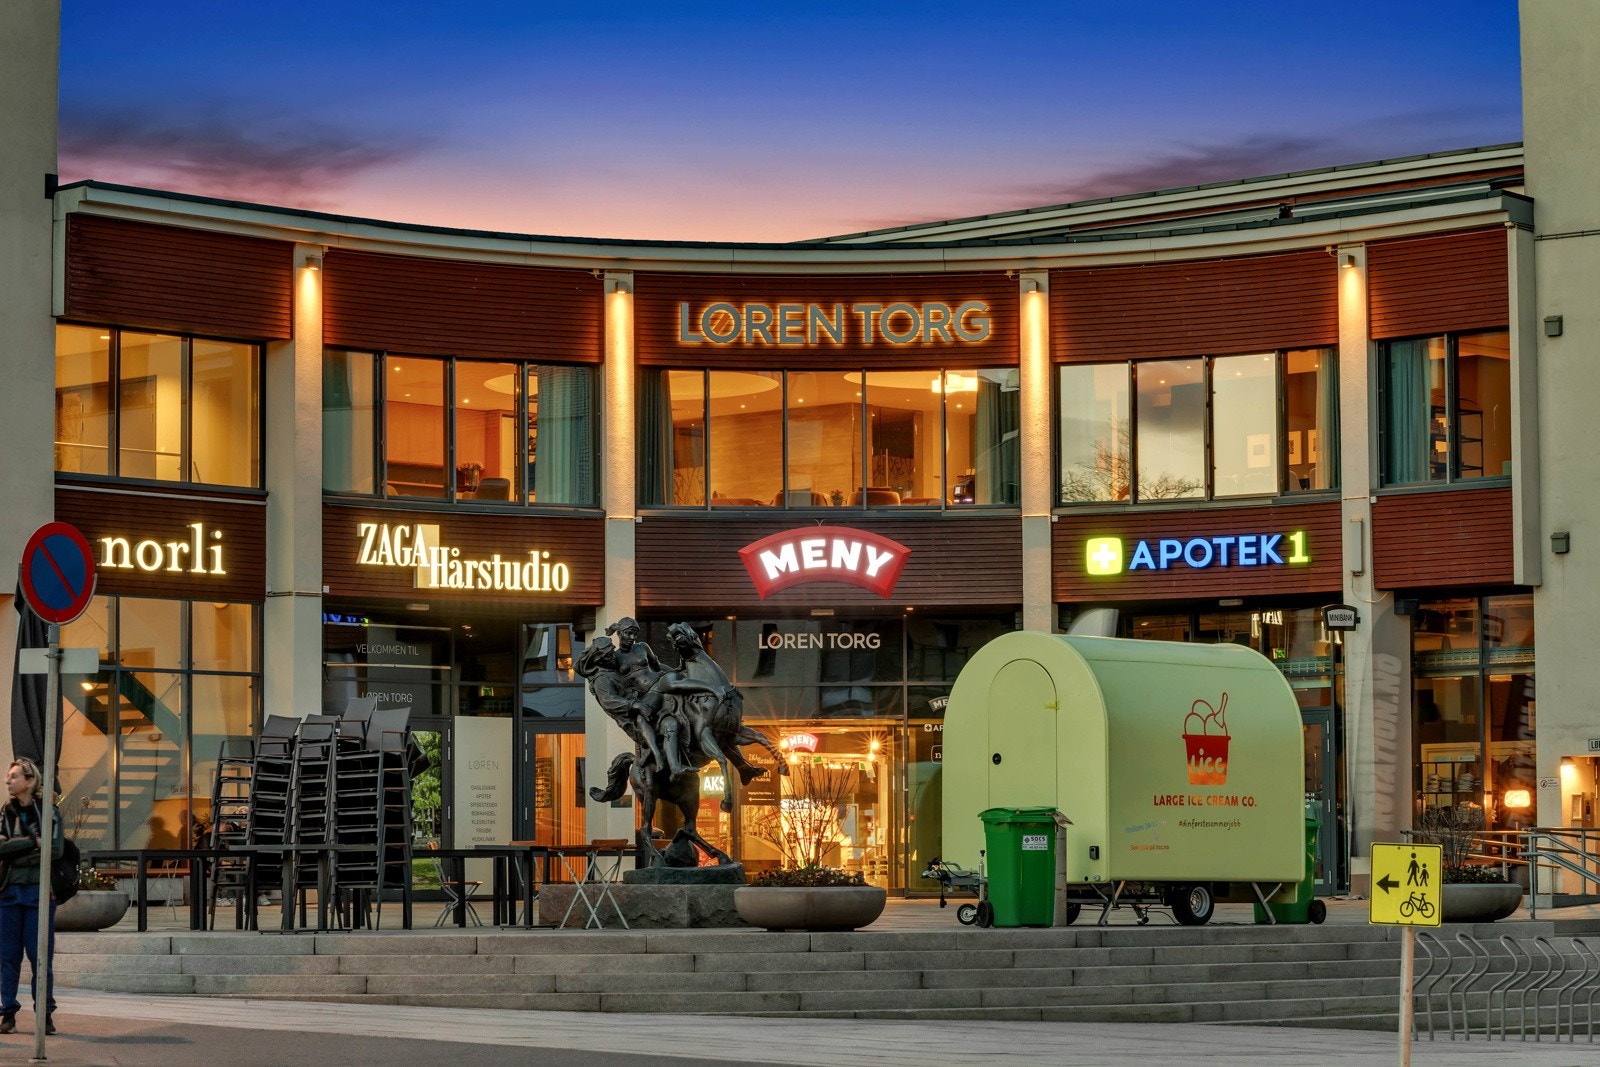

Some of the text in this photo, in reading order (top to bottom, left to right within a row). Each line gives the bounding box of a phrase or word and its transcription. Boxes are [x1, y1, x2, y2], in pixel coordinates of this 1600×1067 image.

[853, 301, 991, 343] TORG
[97, 522, 226, 575] norli
[357, 523, 431, 567] ZAGA
[1129, 531, 1311, 570] APOTEK 1
[429, 547, 570, 592] Hårstudio
[759, 538, 895, 580] MENY
[1329, 613, 1353, 622] MINIBANK
[356, 644, 419, 656] VELKOMMEN TIL
[827, 633, 881, 649] TORG
[390, 692, 413, 703] TORG
[788, 735, 815, 748] MENY
[1153, 794, 1257, 807] LARGE ICE CREAM CO.
